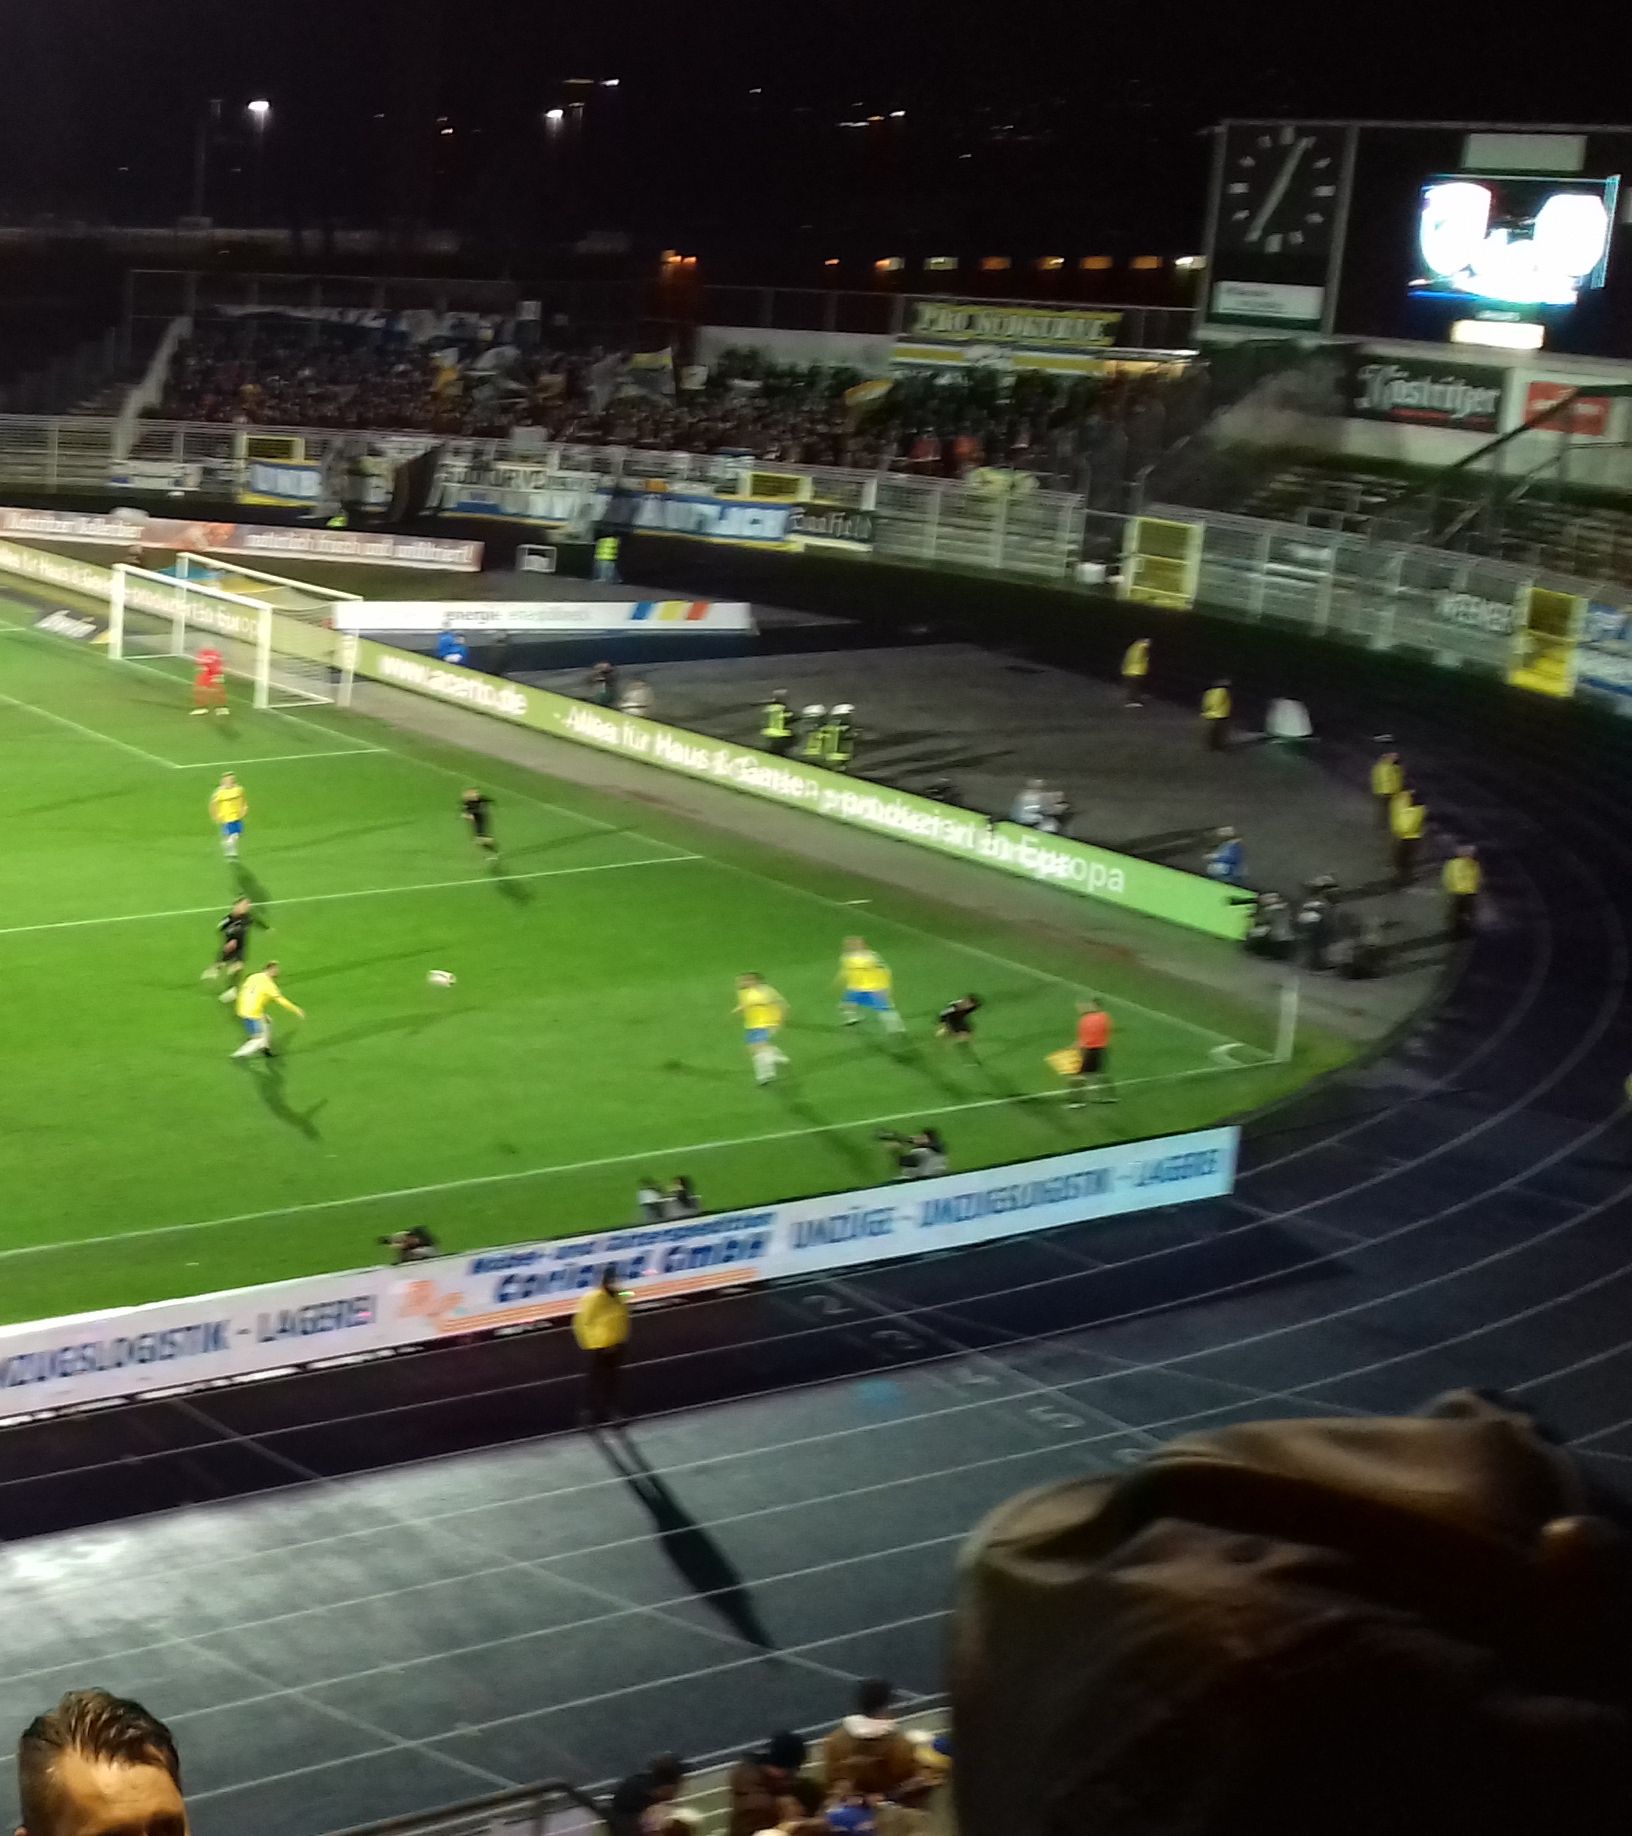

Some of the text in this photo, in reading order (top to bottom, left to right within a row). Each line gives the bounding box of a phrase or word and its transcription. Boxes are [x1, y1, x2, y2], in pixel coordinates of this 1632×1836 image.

[654, 731, 711, 771] Haus
[1015, 832, 1126, 894] Europa
[494, 1252, 652, 1305] Coriad
